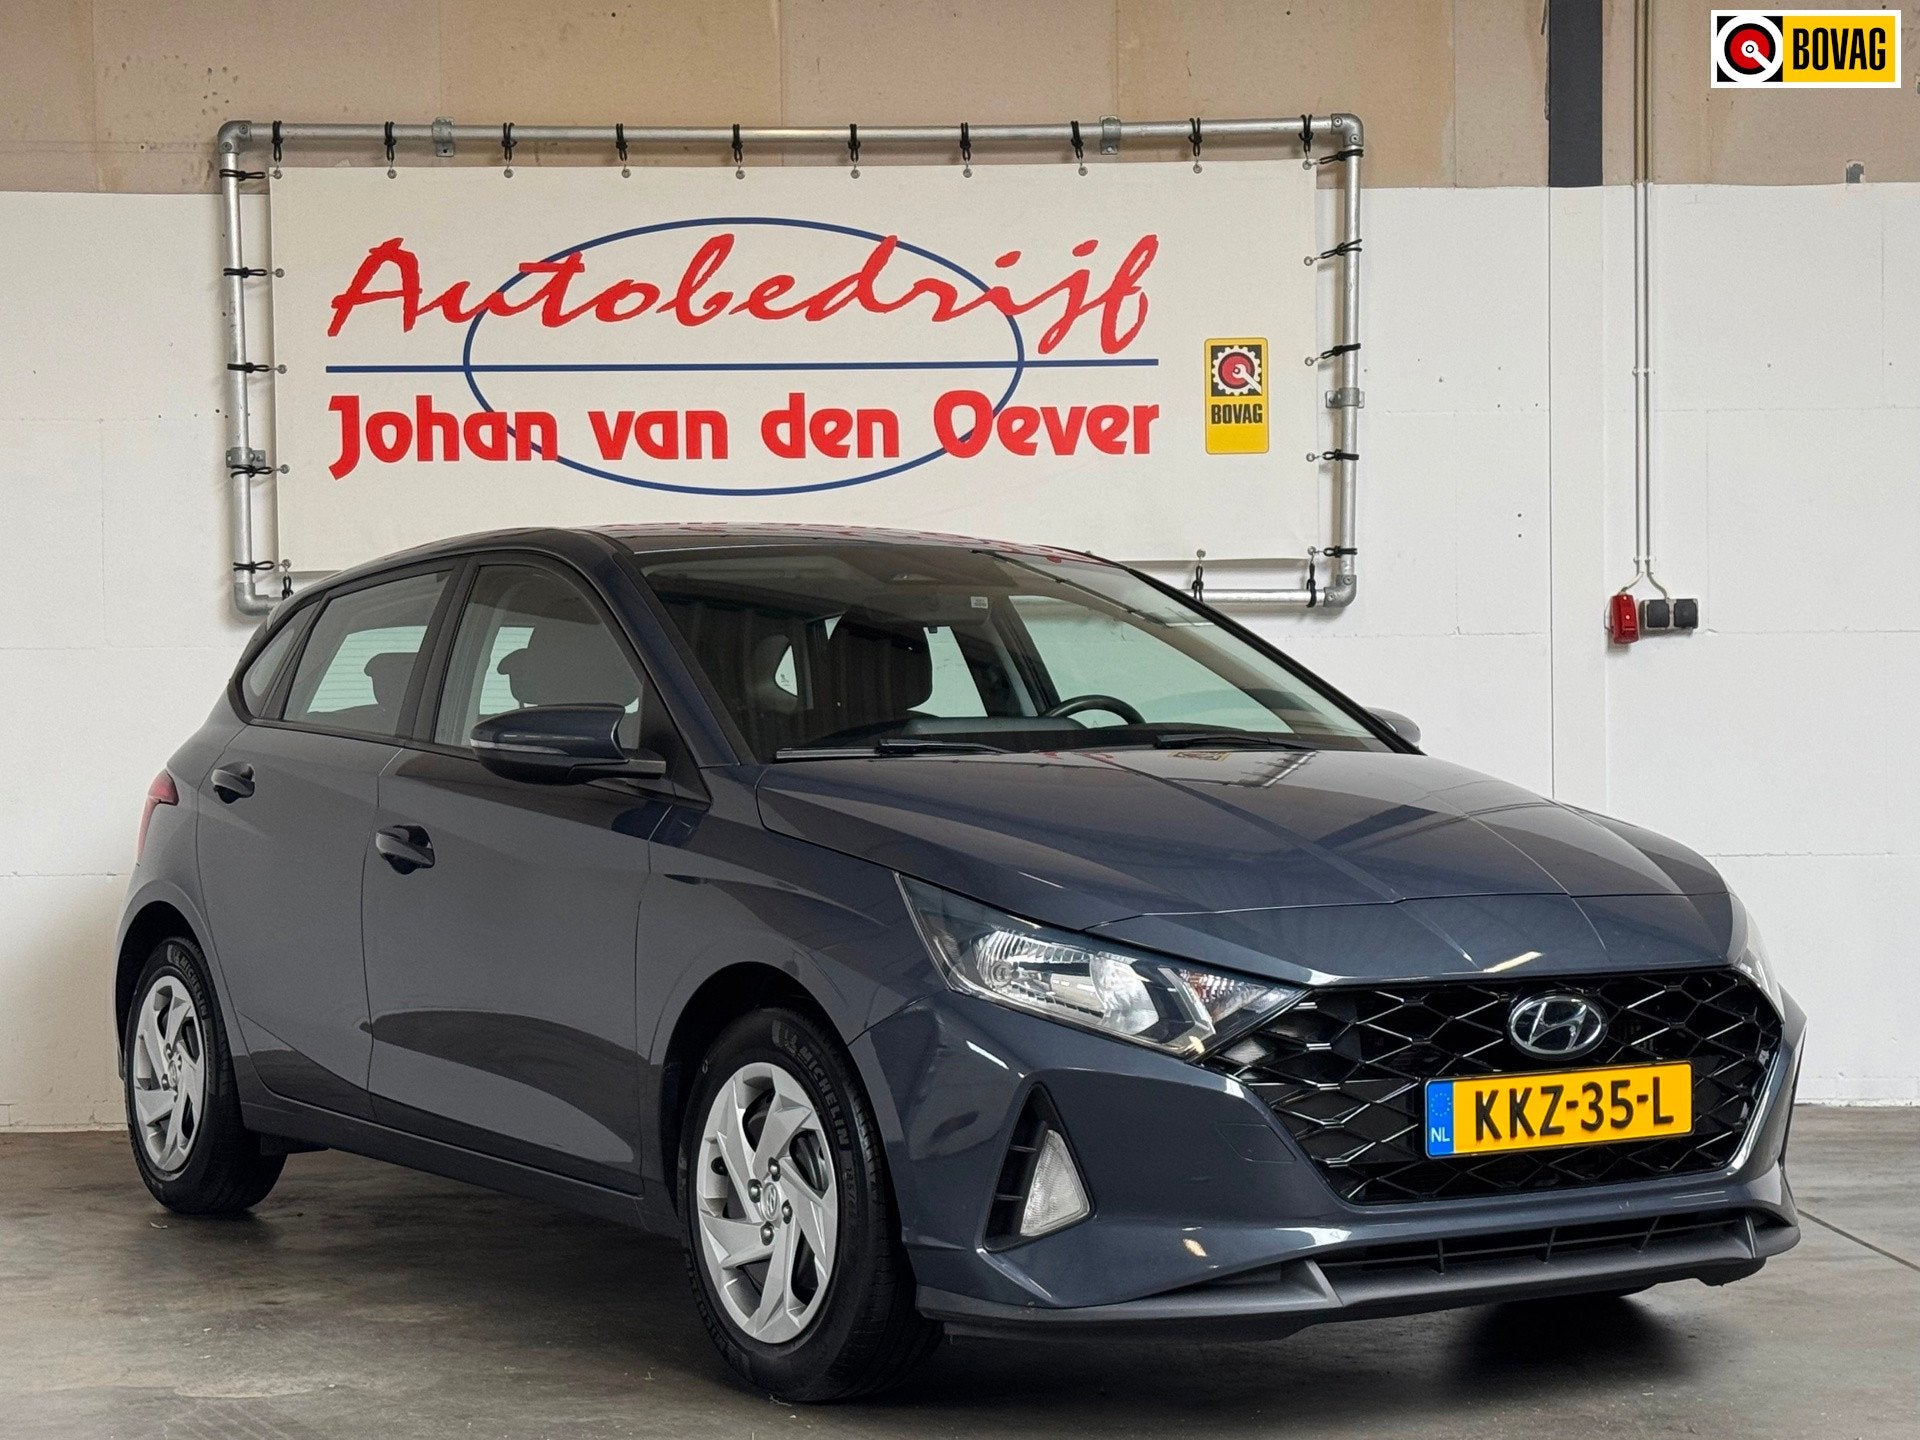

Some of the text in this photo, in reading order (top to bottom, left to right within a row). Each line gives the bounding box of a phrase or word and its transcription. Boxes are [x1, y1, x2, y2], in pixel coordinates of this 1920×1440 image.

[328, 234, 1158, 354] Autobedrijf
[328, 389, 1160, 480] Johan van den Oever
[1211, 404, 1263, 424] BOVAG
[796, 1045, 851, 1150] MICHELIN
[1430, 1127, 1451, 1143] NL
[1474, 1076, 1675, 1141] KKZ-35-L
